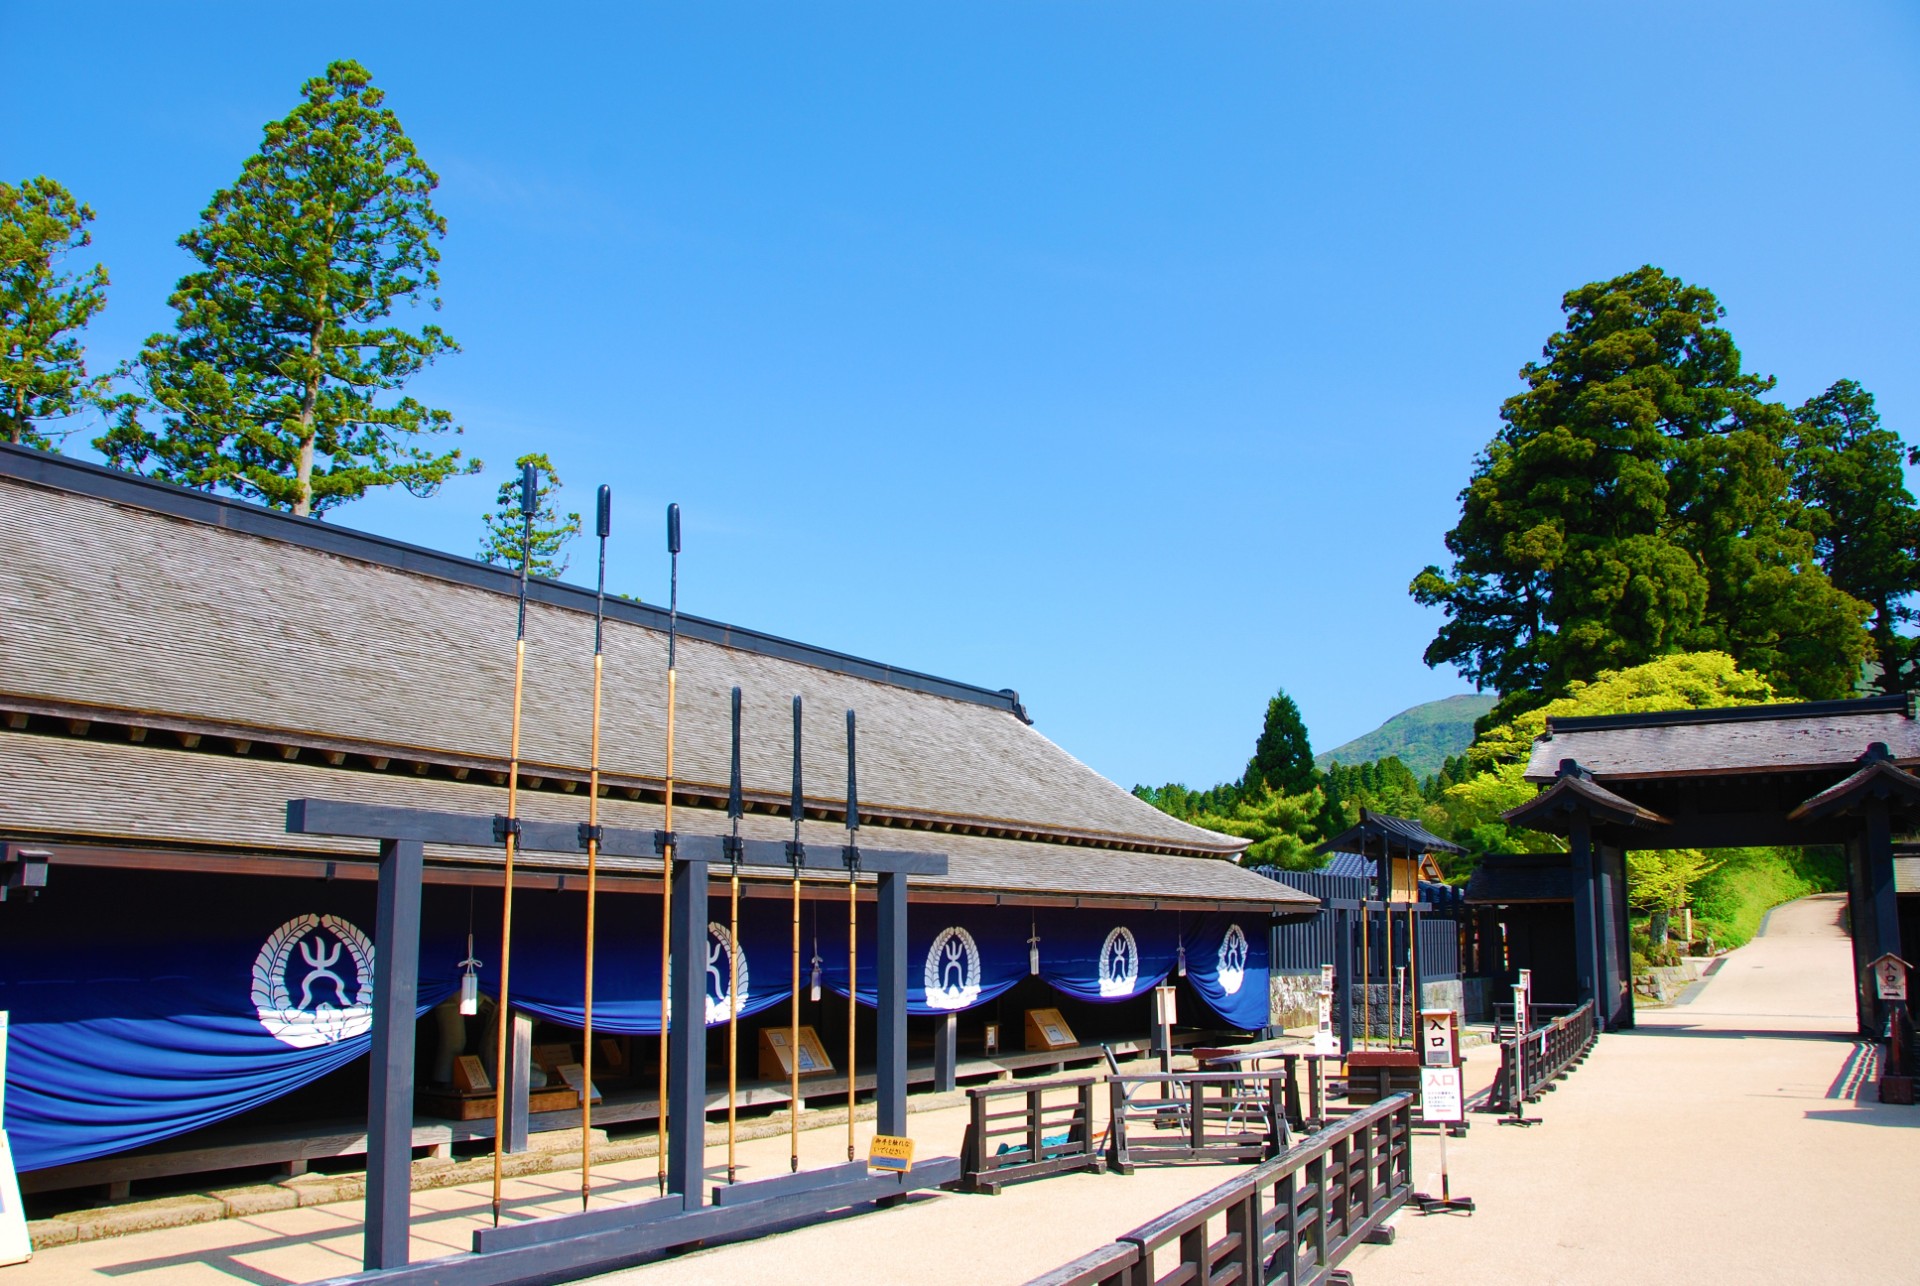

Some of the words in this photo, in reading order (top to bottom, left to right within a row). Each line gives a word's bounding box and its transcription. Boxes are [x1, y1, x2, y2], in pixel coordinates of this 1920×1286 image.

[1885, 962, 1897, 982] 入口
[1430, 1019, 1445, 1047] 入口
[1428, 1074, 1454, 1086] 入口
